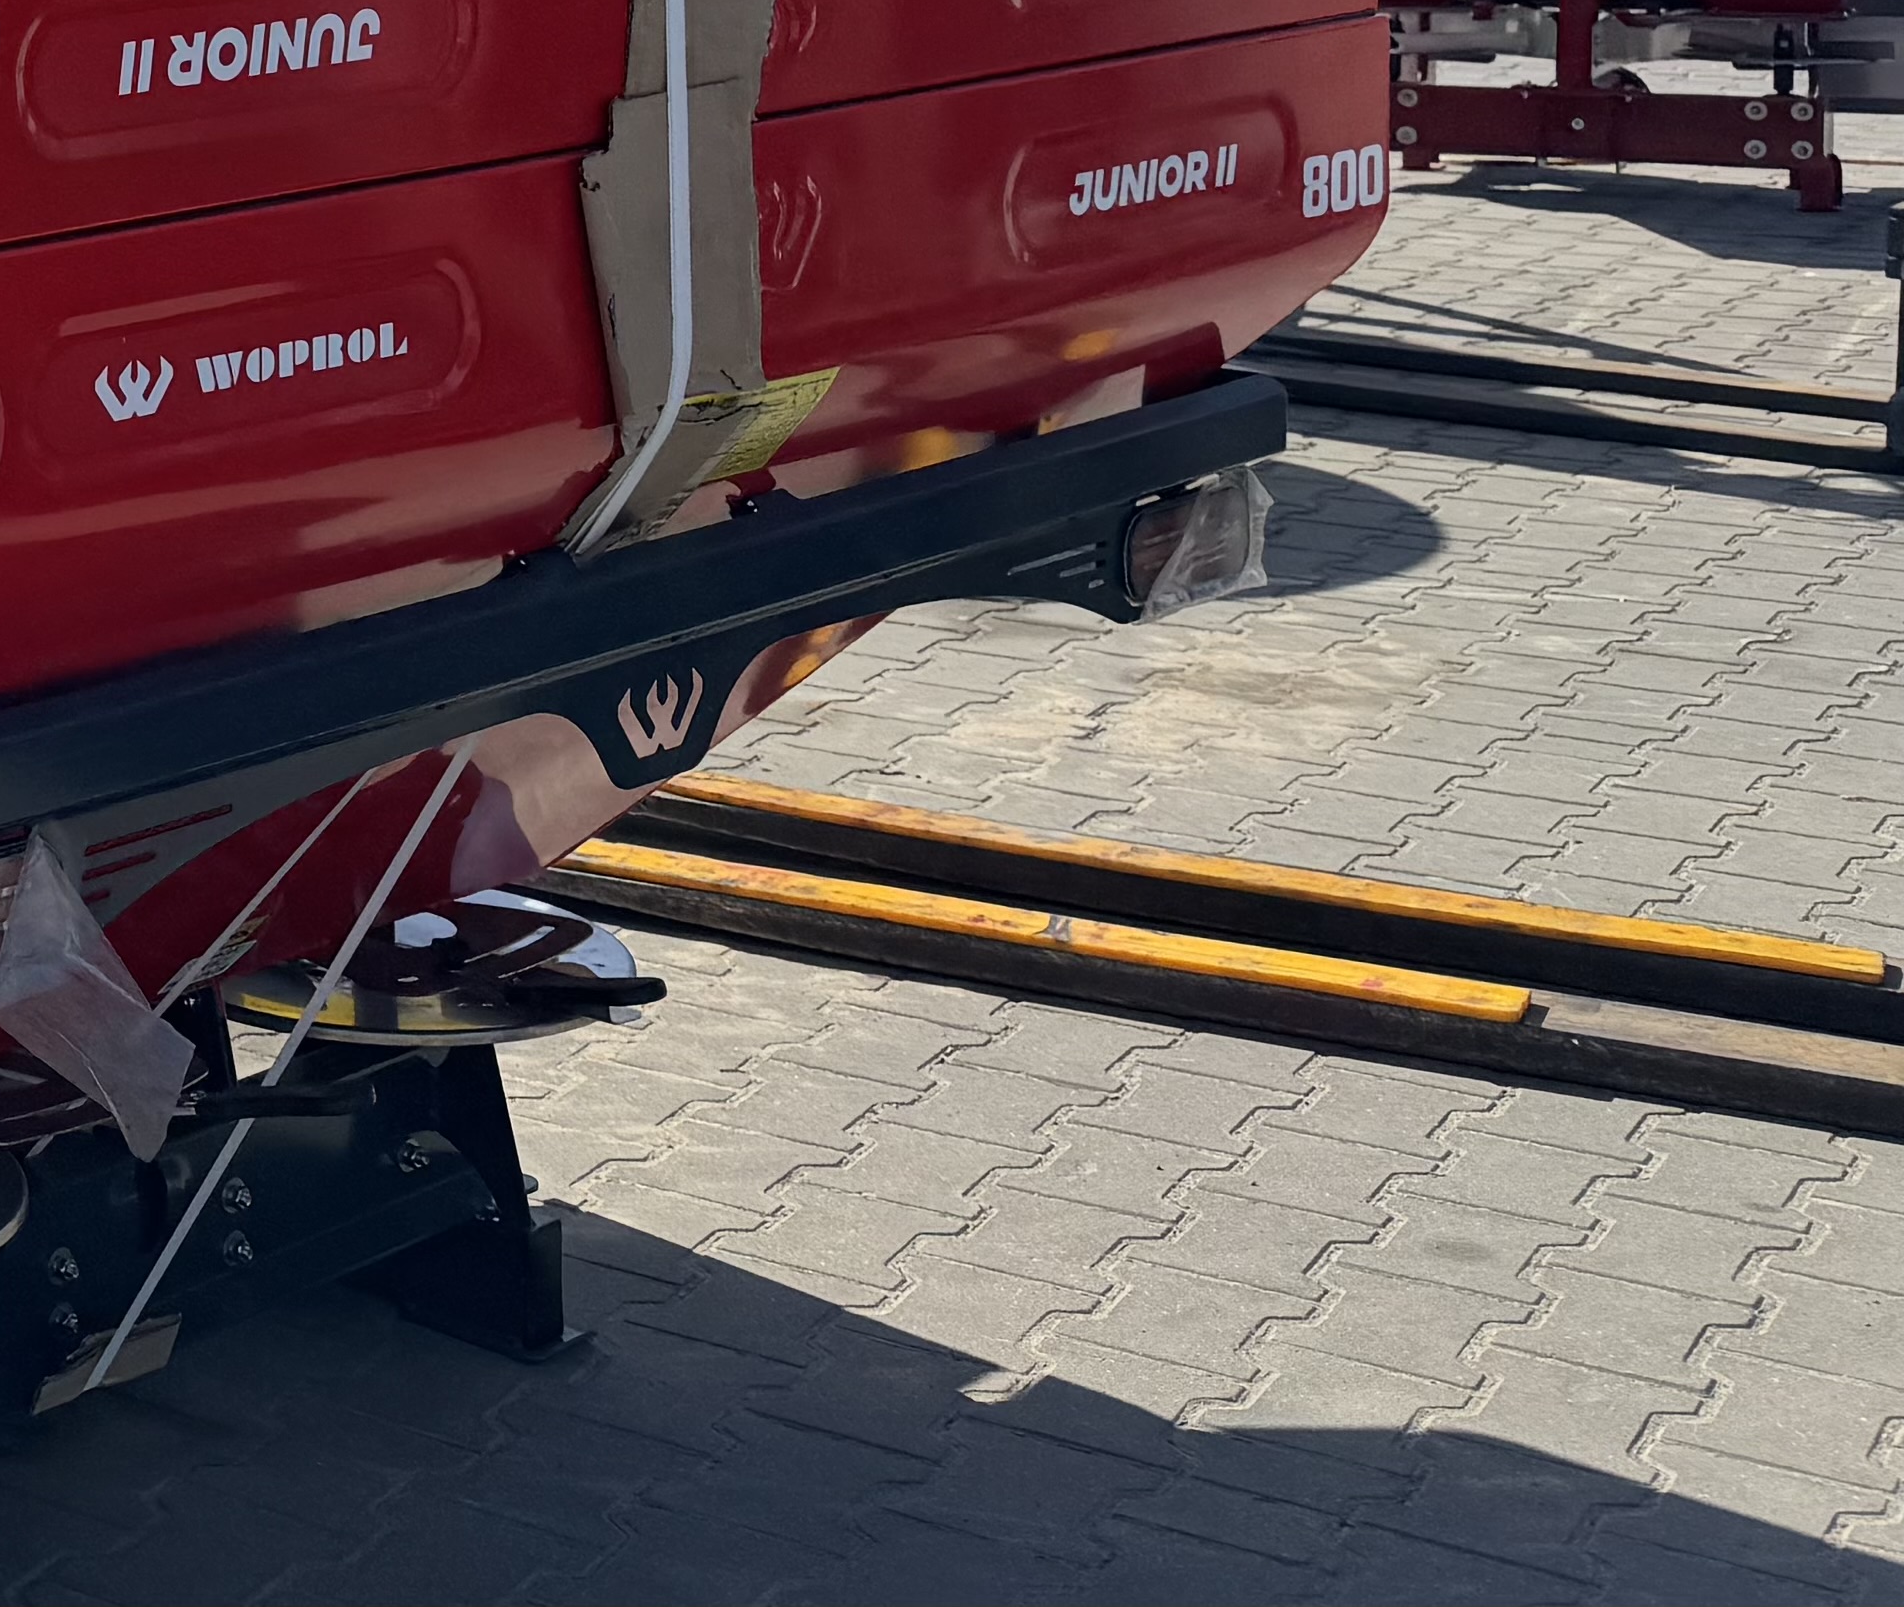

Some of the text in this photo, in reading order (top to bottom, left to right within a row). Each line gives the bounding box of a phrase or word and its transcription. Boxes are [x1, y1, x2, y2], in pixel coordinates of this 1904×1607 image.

[118, 8, 381, 96] JUNIOR II
[1069, 144, 1238, 216] JUNIOR II
[1302, 144, 1385, 218] 800
[195, 322, 408, 393] WOPROL
